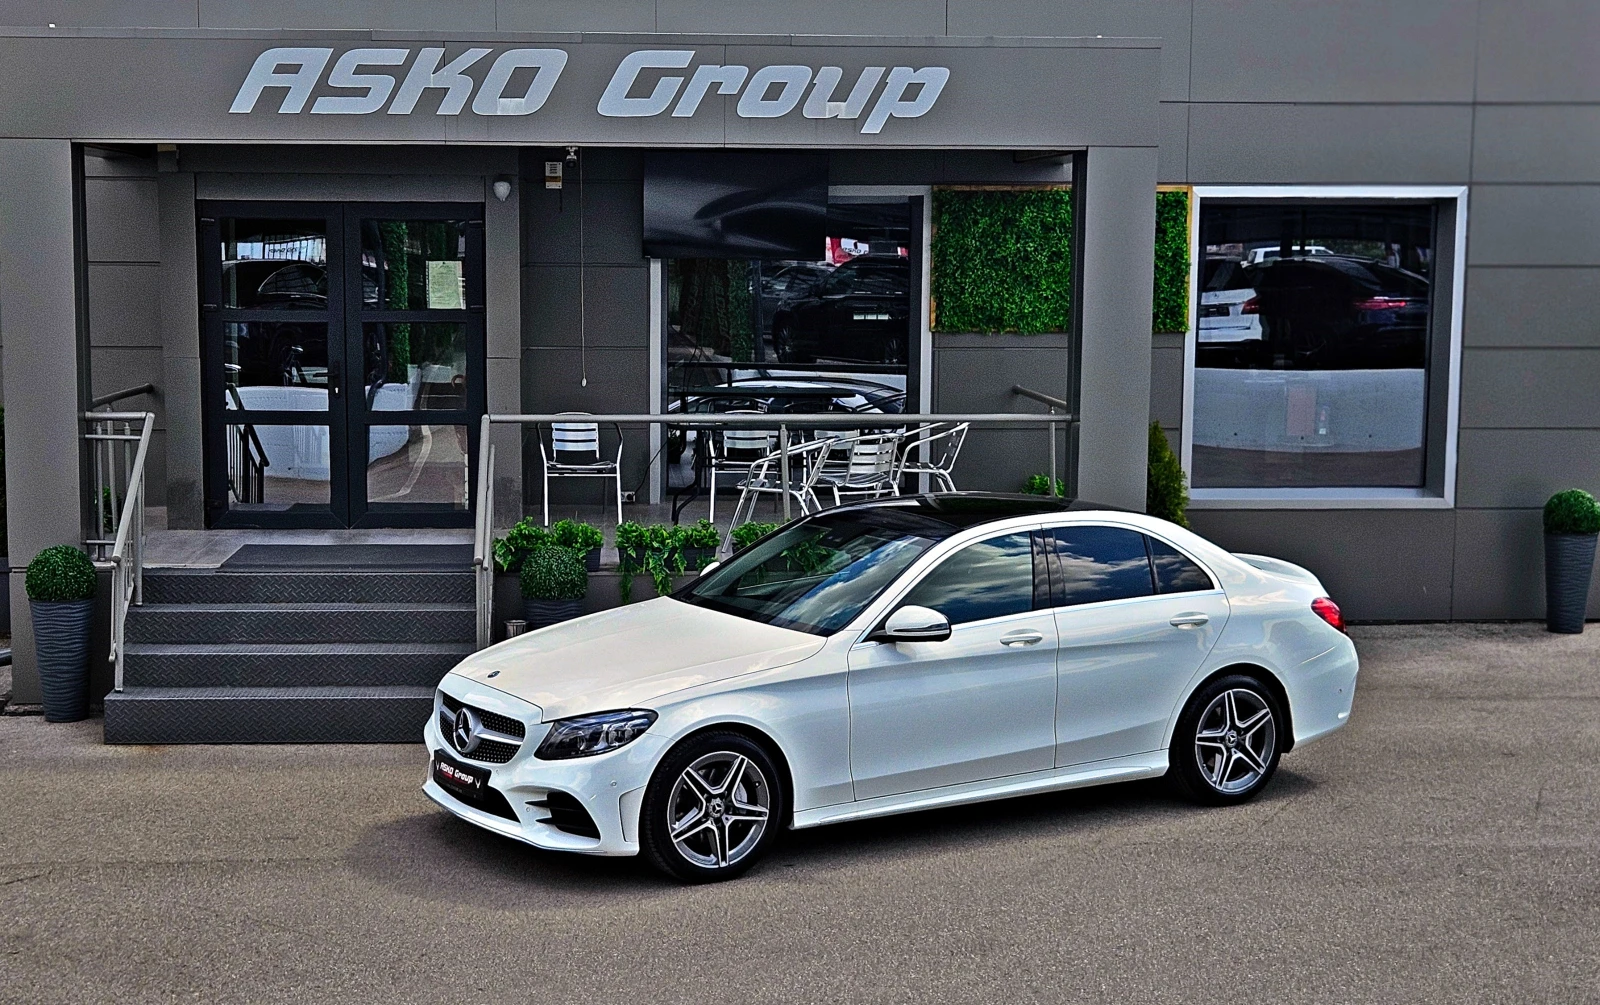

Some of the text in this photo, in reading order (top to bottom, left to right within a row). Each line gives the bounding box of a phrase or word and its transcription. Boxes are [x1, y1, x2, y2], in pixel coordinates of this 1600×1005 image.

[229, 47, 950, 134] ASKO Group
[440, 761, 474, 783] ASKO Group
